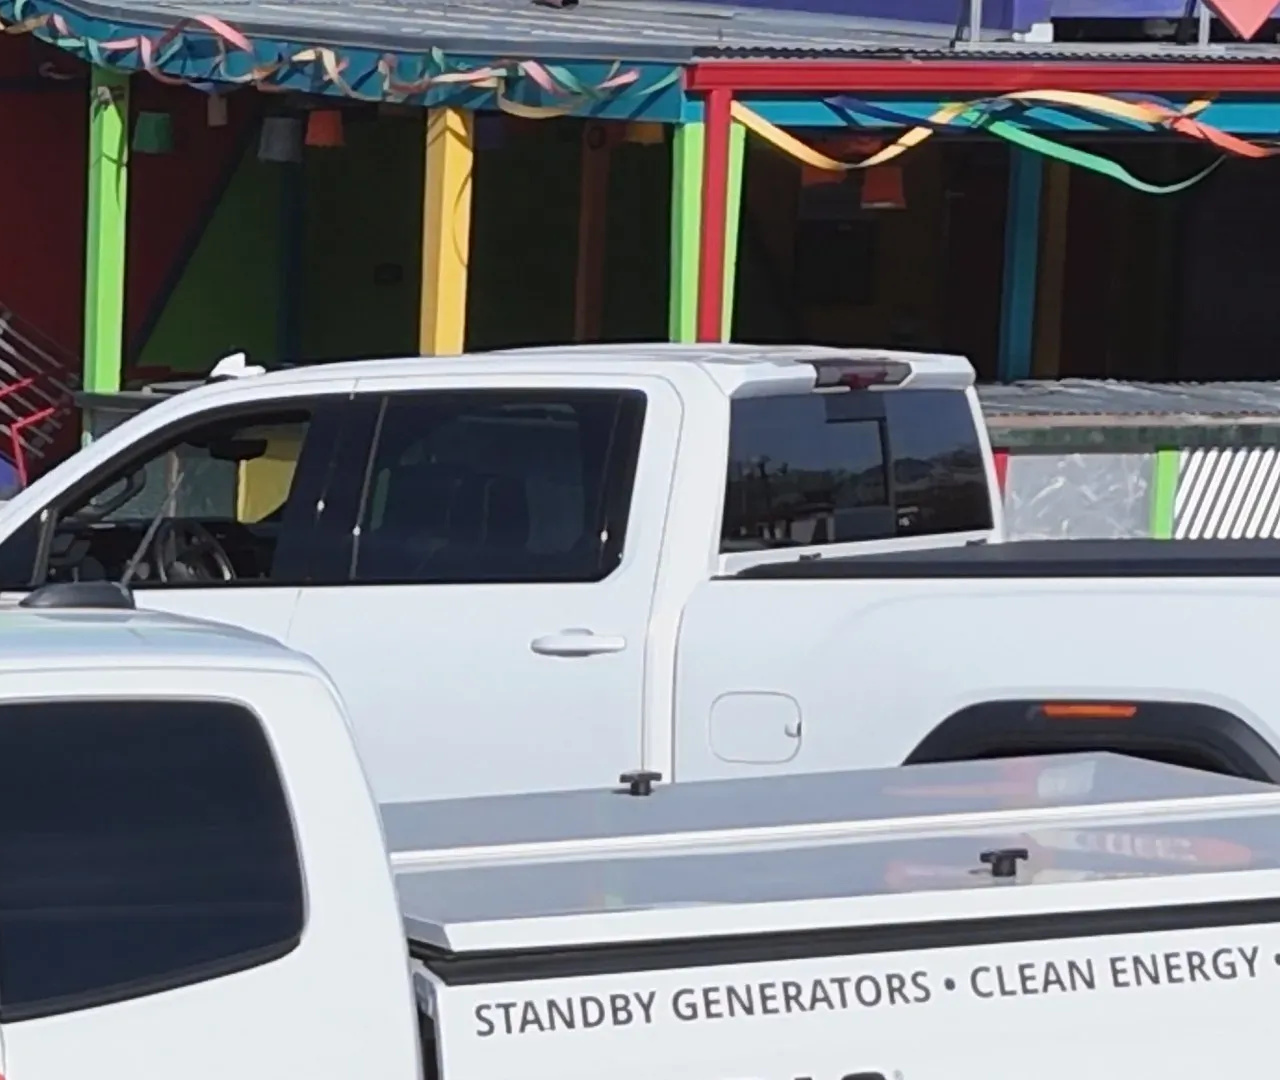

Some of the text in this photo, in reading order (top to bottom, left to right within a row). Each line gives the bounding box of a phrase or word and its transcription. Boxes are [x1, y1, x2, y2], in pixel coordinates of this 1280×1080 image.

[474, 946, 1260, 1037] STANDBY GENERATORS CLEAN ENERGY
